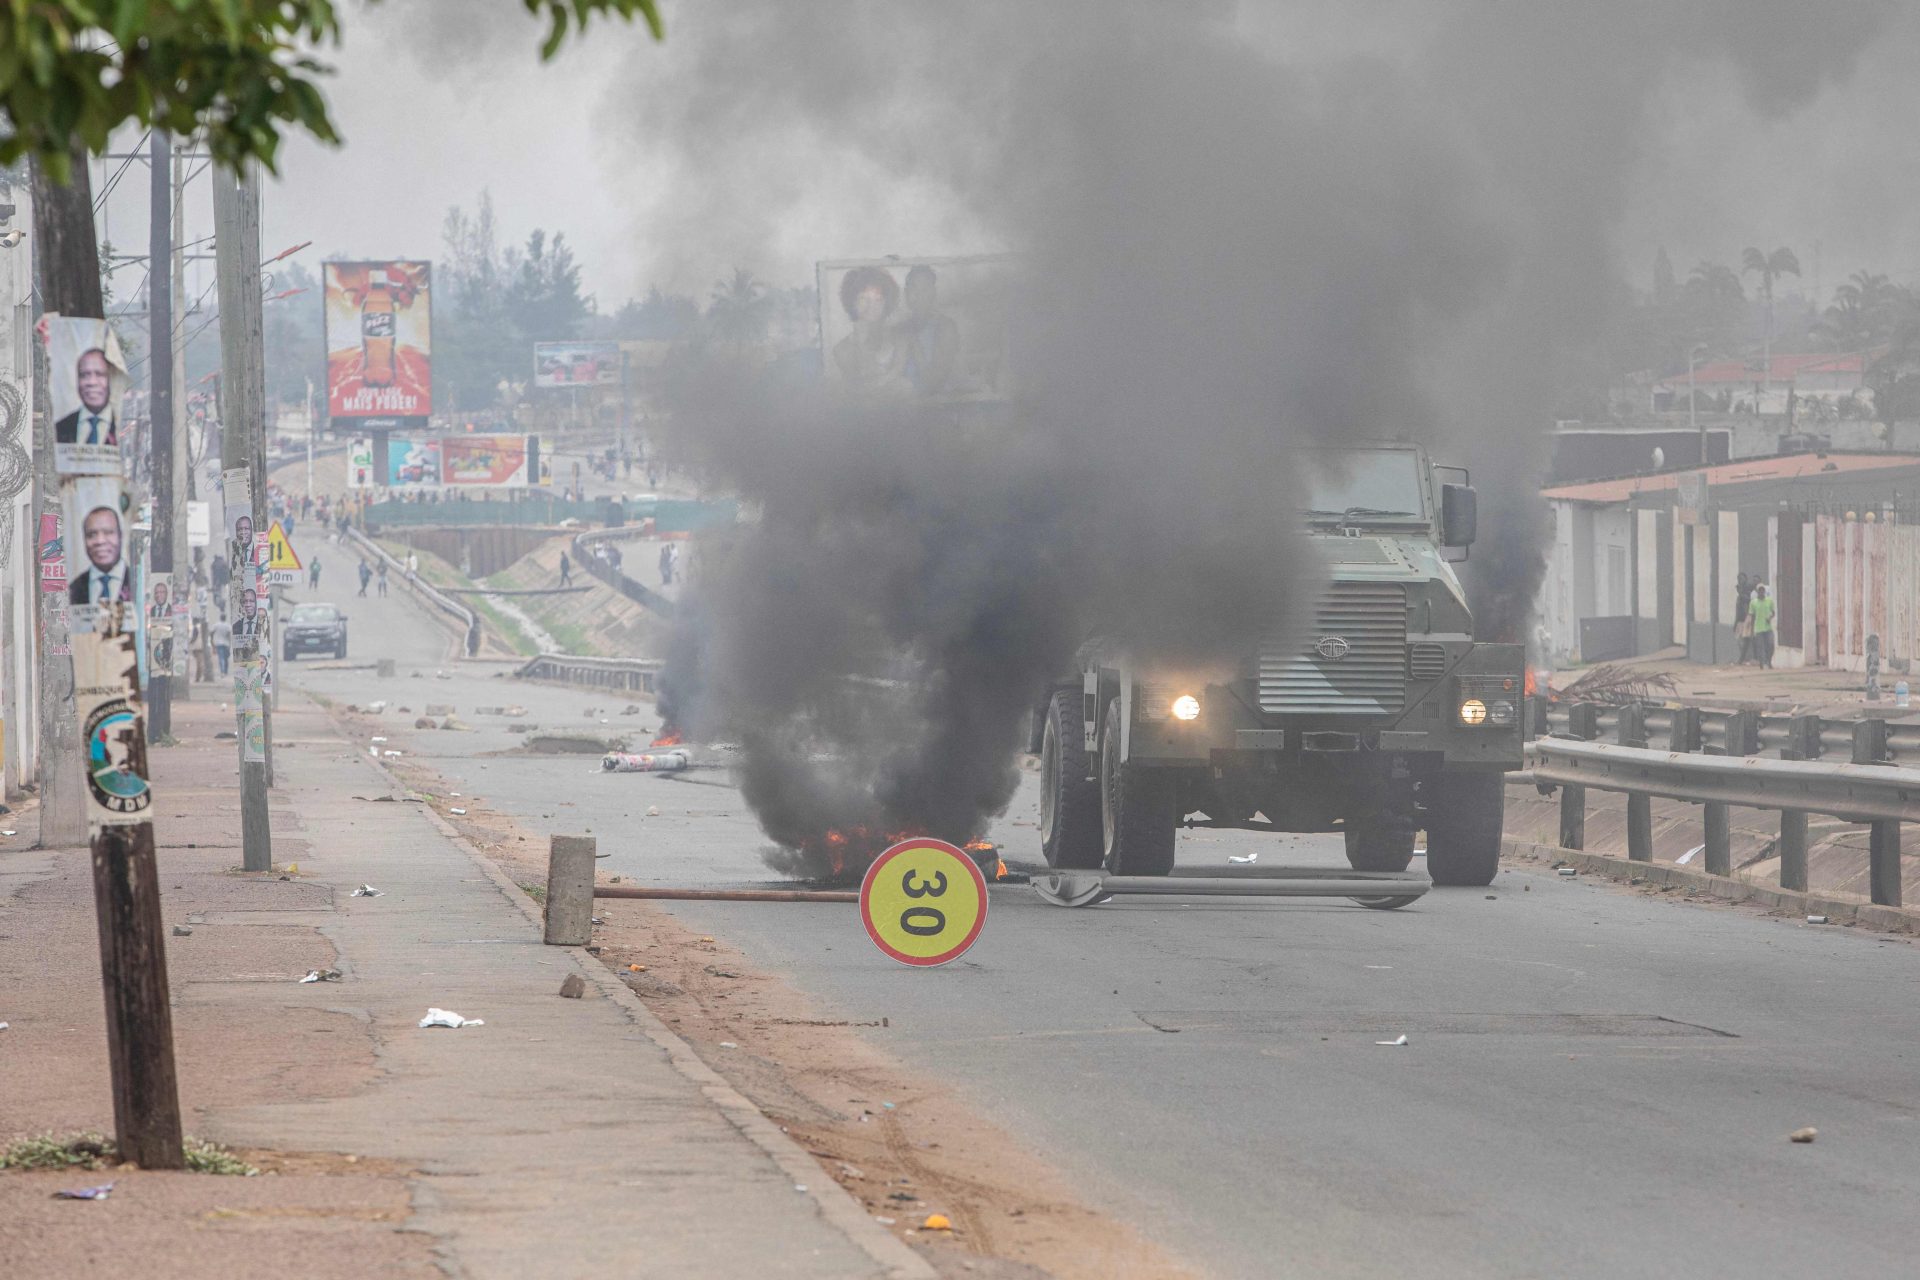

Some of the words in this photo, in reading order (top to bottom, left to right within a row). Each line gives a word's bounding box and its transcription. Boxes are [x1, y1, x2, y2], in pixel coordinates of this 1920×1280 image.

[343, 396, 372, 411] MAIS
[376, 395, 417, 410] PODER!
[107, 794, 148, 812] MDM
[900, 869, 948, 936] 30
